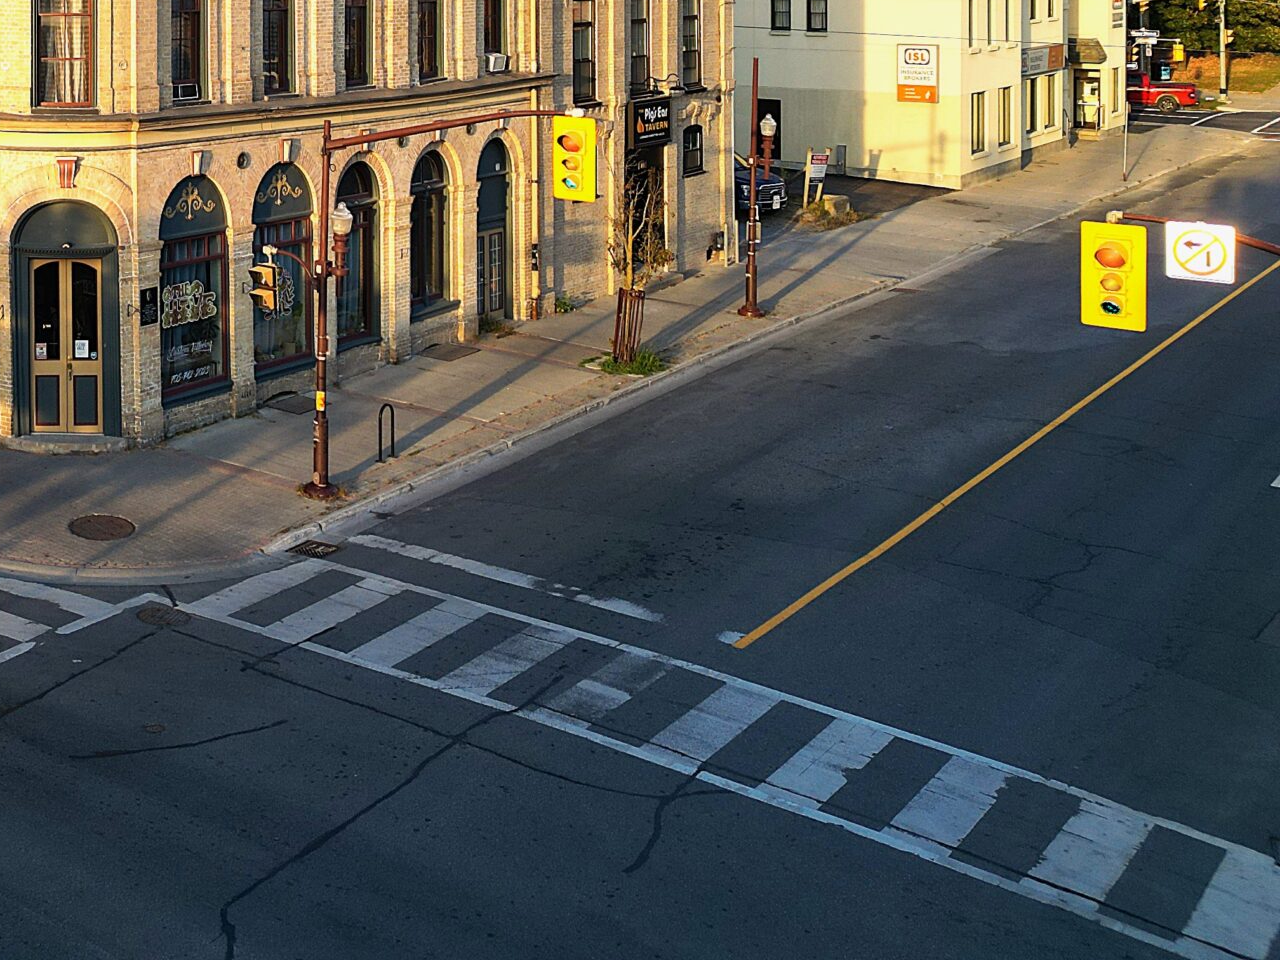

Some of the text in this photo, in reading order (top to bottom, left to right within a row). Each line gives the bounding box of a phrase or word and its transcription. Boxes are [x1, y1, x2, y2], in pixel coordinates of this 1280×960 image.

[908, 52, 926, 61] ISL
[644, 106, 668, 122] Pig's Ear
[645, 121, 668, 131] TAVERN
